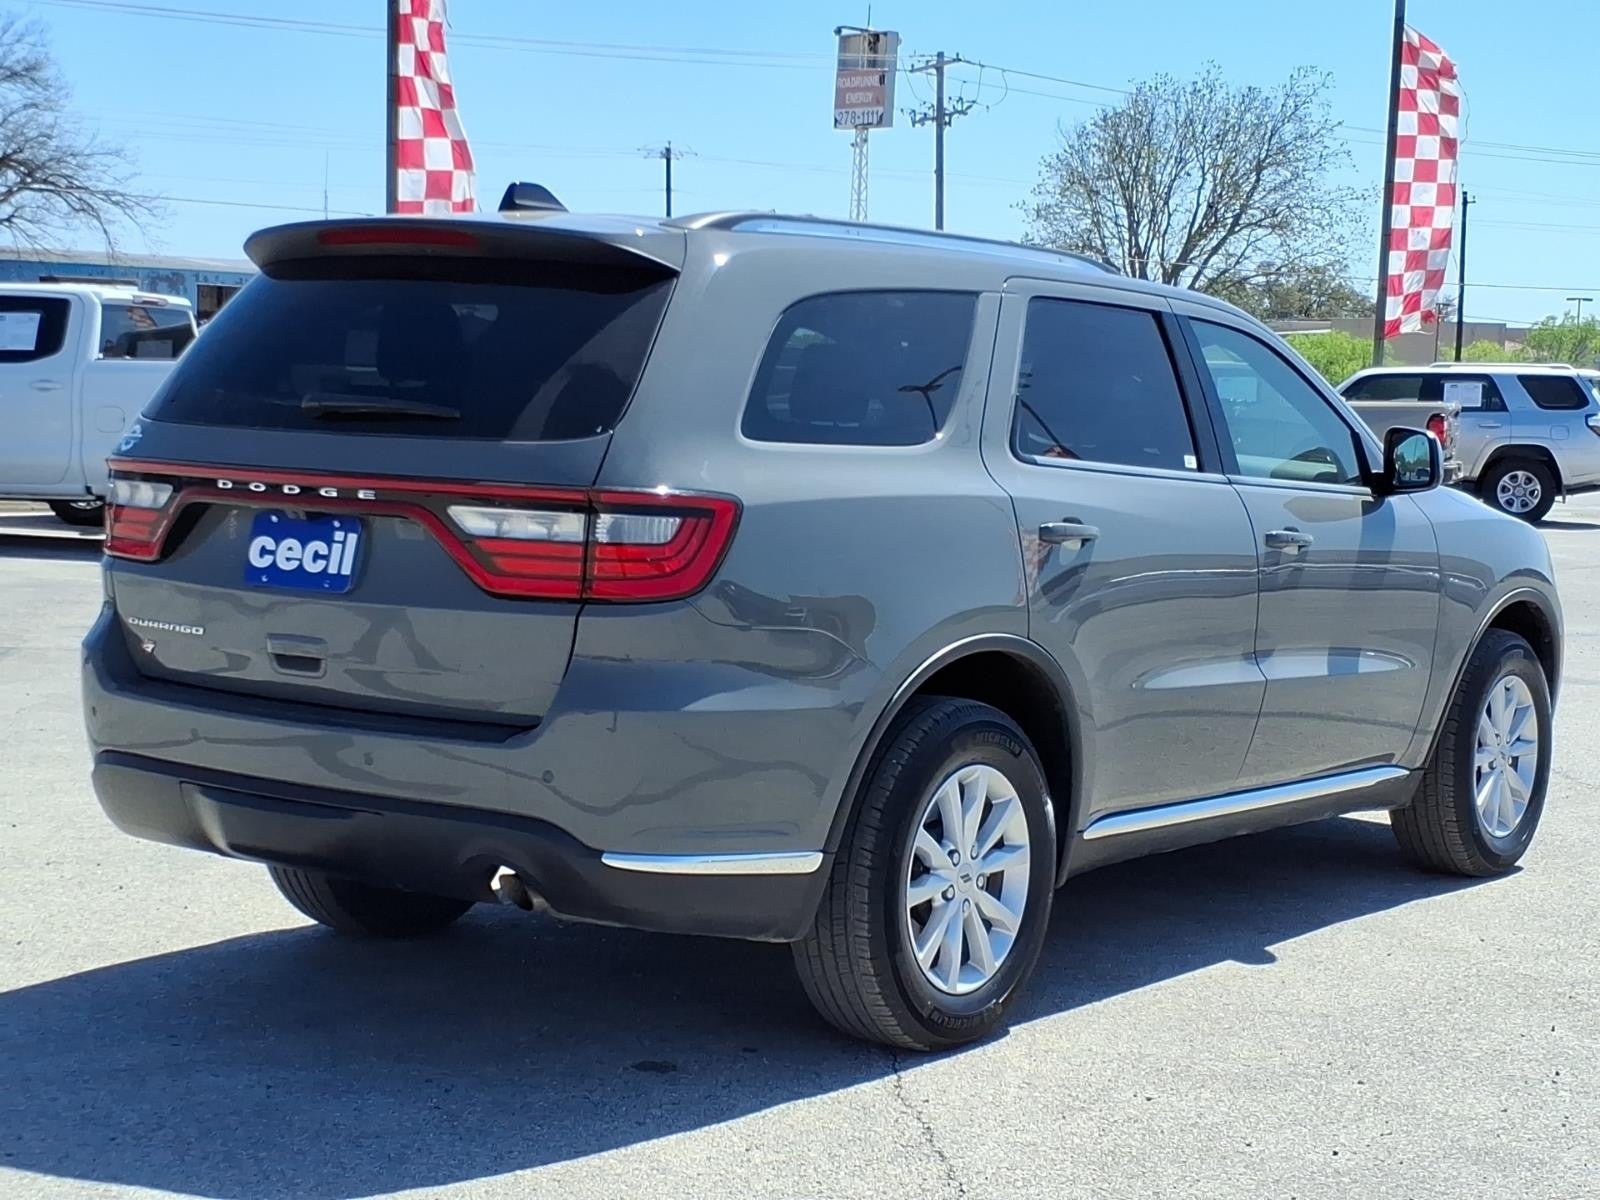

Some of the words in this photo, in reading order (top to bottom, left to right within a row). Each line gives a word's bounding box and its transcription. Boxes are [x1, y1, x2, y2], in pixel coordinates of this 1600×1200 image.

[837, 74, 885, 88] ROADRUNNE
[845, 92, 873, 105] ENERGY
[837, 109, 880, 126] 278-1111
[216, 479, 376, 499] DODGE
[248, 530, 359, 576] cecil
[128, 617, 204, 635] DURANGO
[975, 731, 1021, 755] MICHELIN
